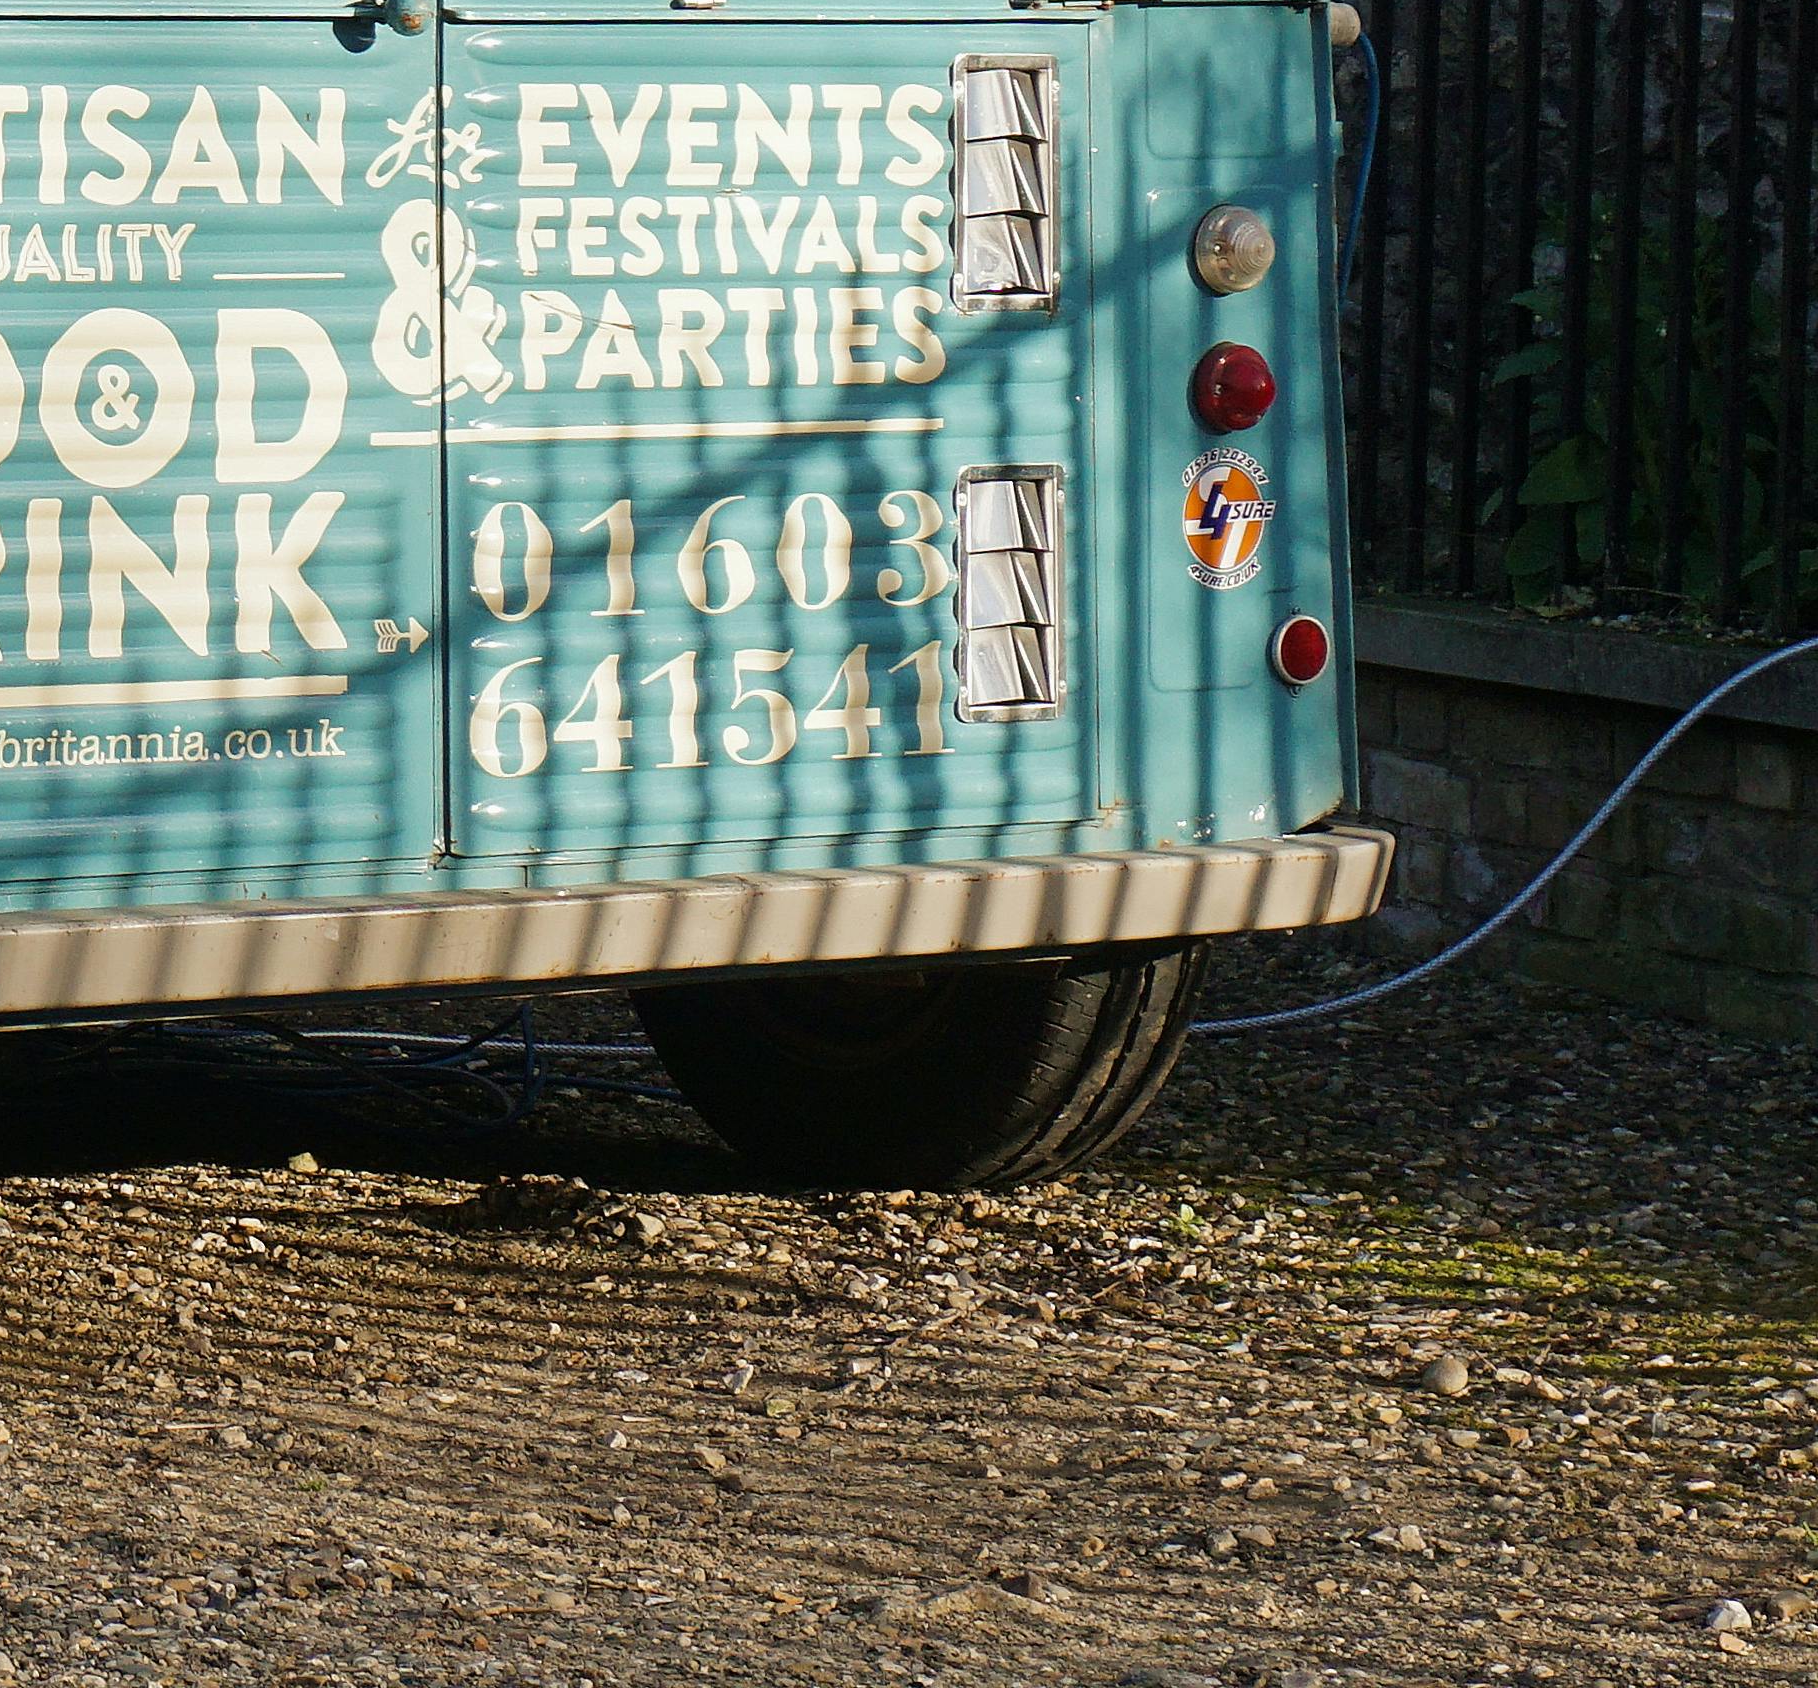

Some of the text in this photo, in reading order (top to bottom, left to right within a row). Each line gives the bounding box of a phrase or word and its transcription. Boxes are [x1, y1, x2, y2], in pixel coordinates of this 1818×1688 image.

[364, 82, 946, 191] for EVENTS
[370, 197, 947, 406] & PARTIES
[517, 194, 946, 276] FESTIVALS
[473, 489, 950, 622] 01603
[469, 639, 956, 779] 641541
